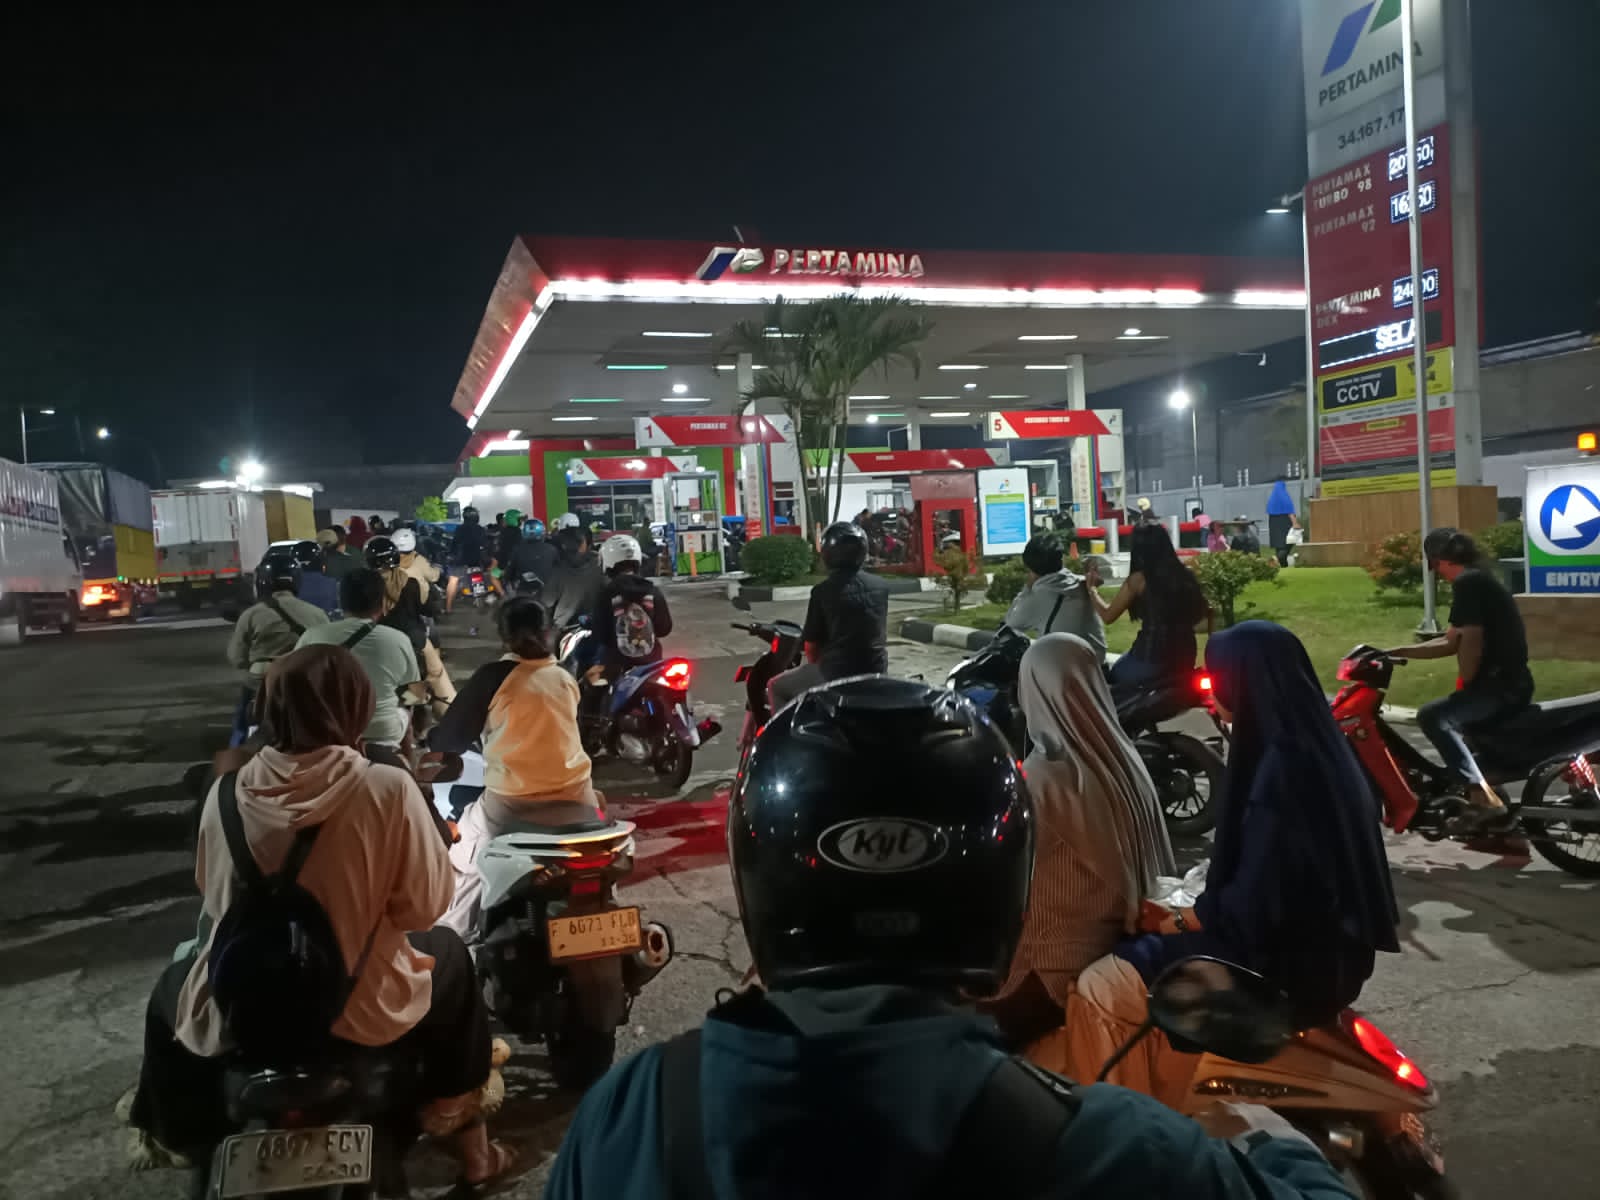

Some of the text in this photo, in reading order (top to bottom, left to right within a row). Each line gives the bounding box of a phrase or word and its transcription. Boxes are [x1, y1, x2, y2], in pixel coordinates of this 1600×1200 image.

[1318, 40, 1423, 107] PERTAMINA
[1312, 163, 1371, 197] PERTAMAX
[1357, 178, 1372, 193] 98
[1313, 205, 1374, 237] PERTAMAX
[770, 248, 924, 278] PERTAMINA
[1336, 381, 1381, 403] CCTV
[645, 425, 653, 439] 1
[994, 418, 1003, 432] 5
[1545, 571, 1600, 587] ENTRY
